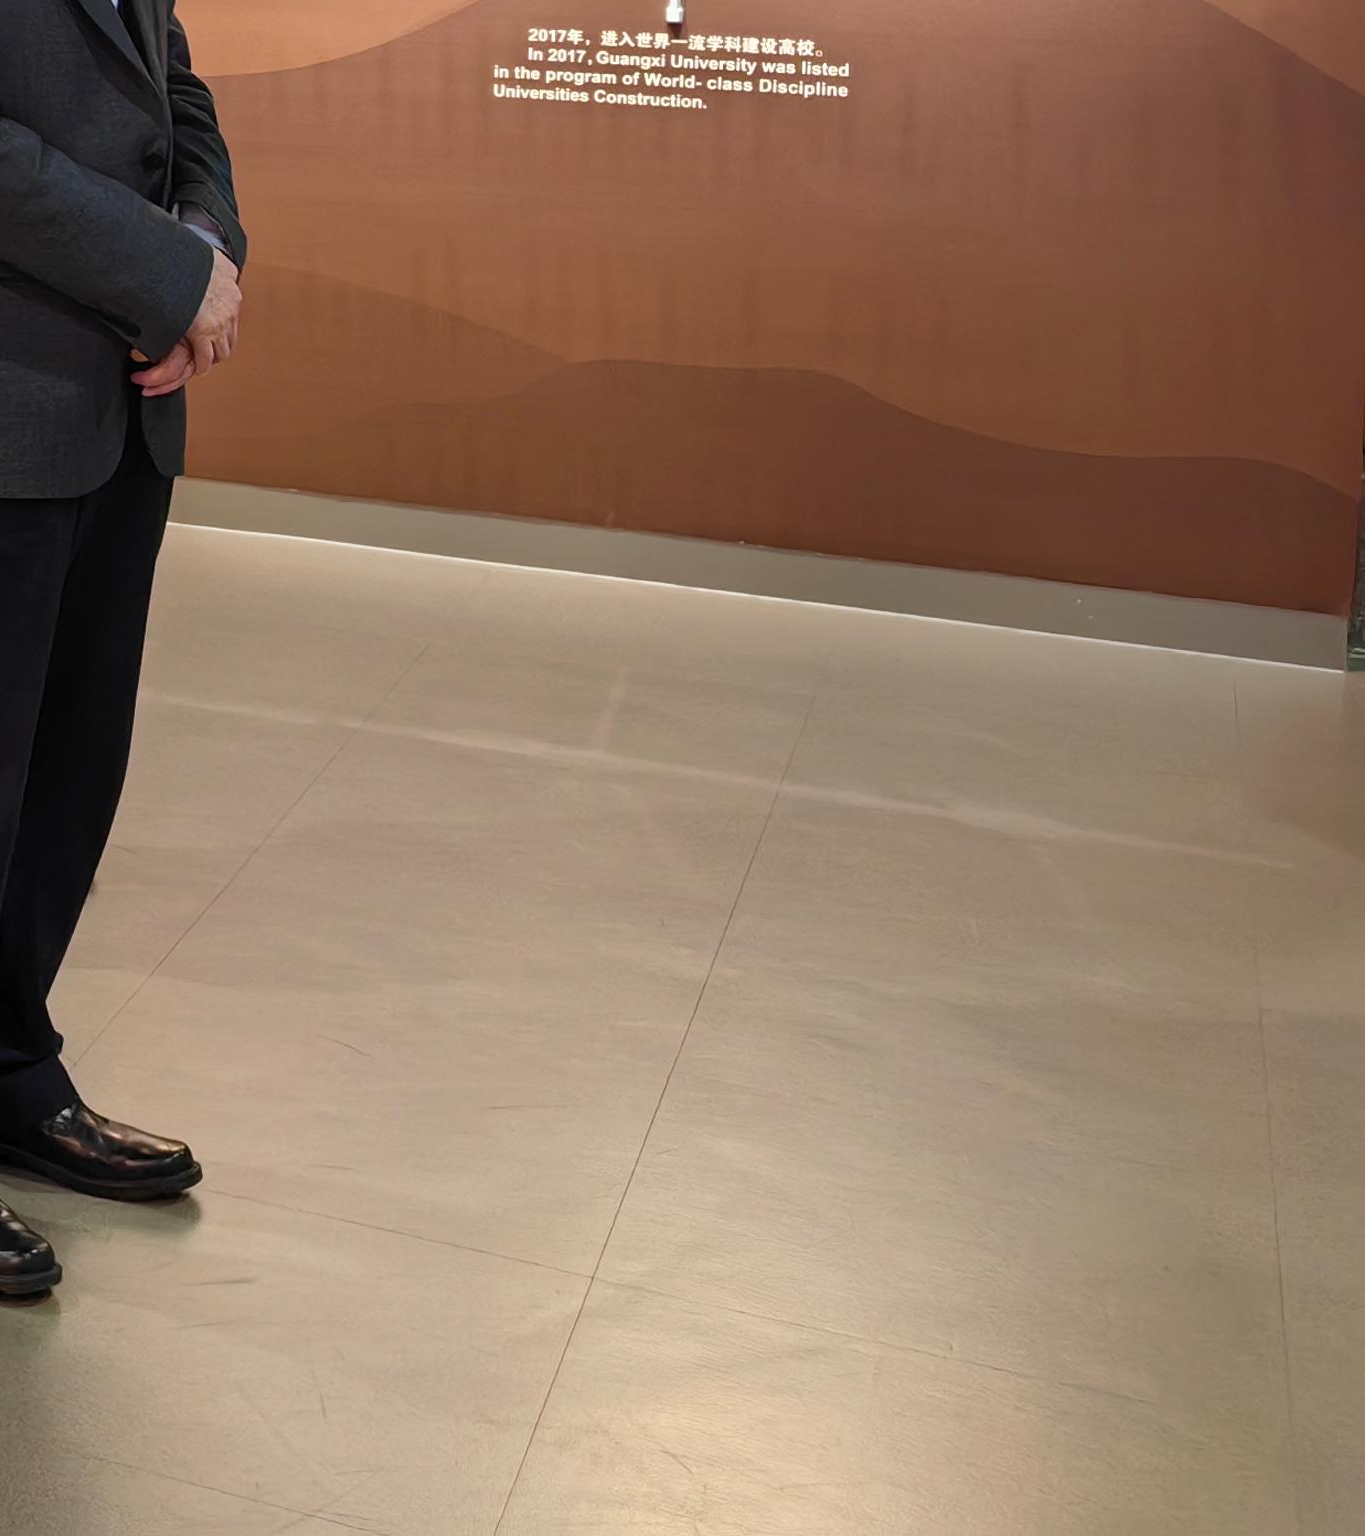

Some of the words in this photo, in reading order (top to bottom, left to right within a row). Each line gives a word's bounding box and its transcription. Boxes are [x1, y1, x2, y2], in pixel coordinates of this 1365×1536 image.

[527, 47, 544, 61] In
[595, 50, 666, 70] Guangxi
[670, 54, 757, 75] University
[761, 62, 796, 75] was
[801, 61, 850, 77] listed
[493, 64, 510, 79] in
[513, 66, 541, 80] the
[545, 70, 617, 86] program
[621, 71, 641, 86] of
[706, 76, 754, 92] class
[758, 78, 849, 98] Discipline
[493, 84, 590, 102] Universities
[593, 89, 707, 109] Construction.
